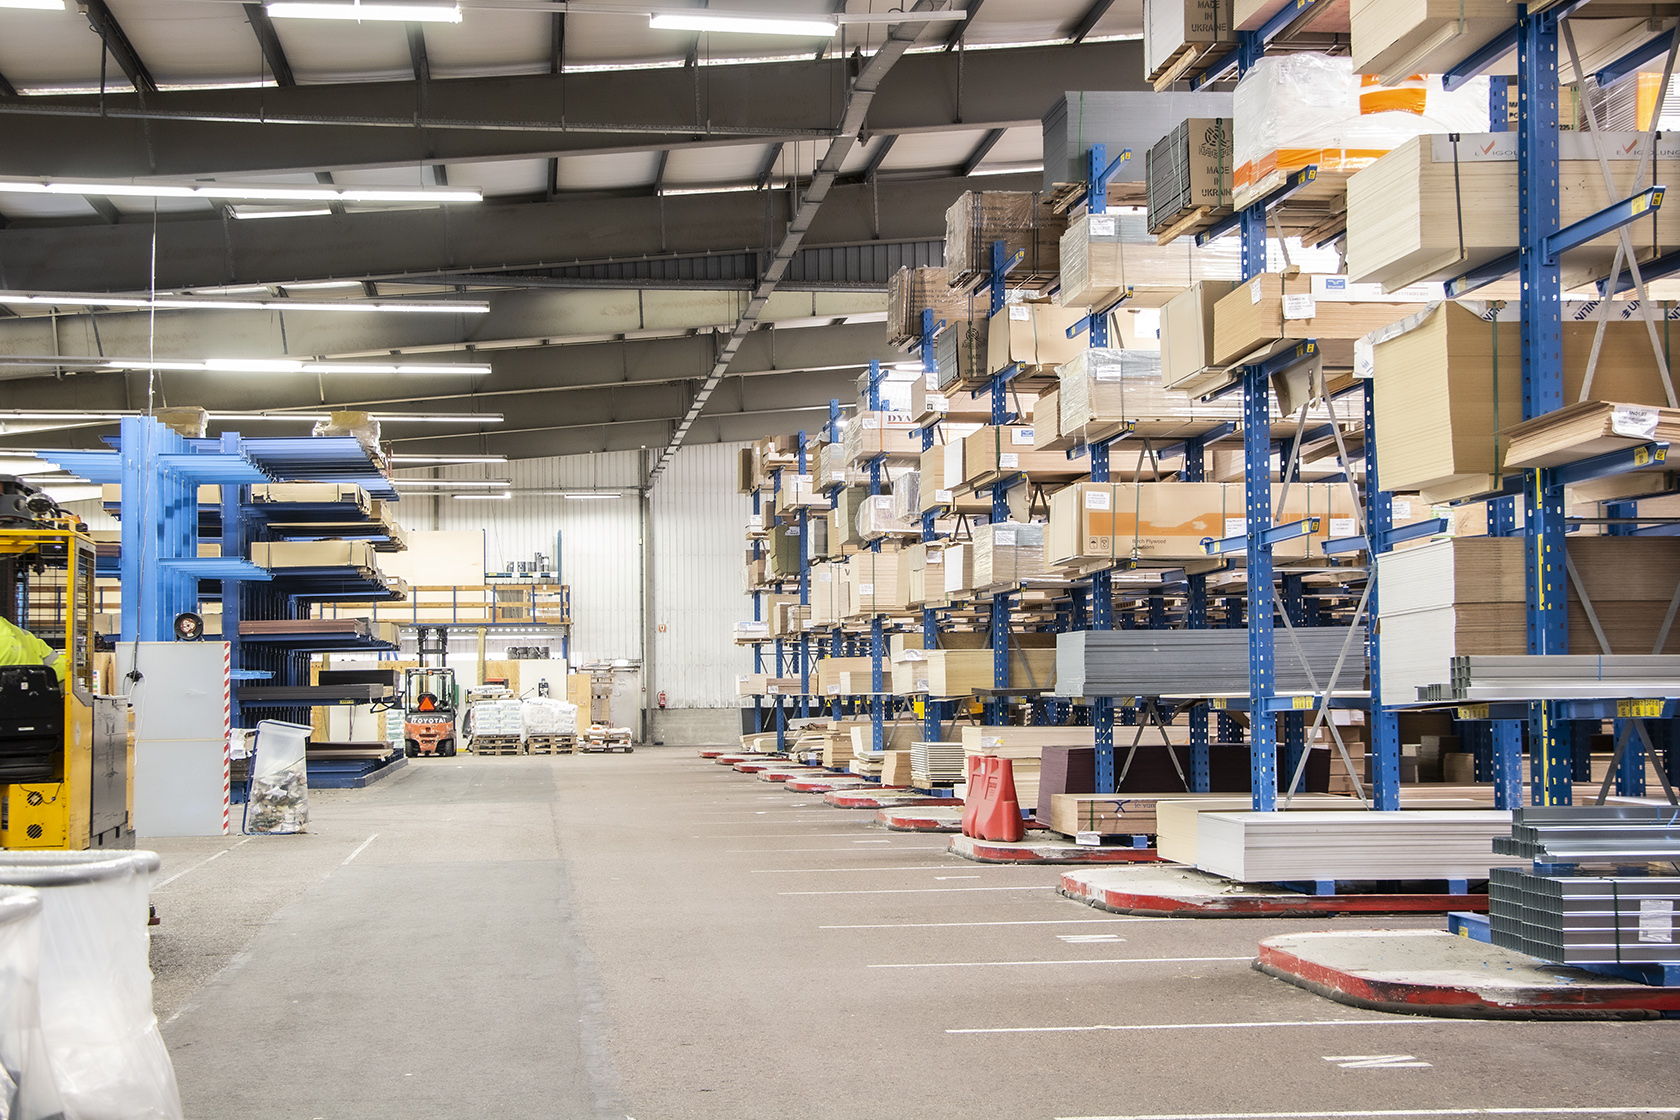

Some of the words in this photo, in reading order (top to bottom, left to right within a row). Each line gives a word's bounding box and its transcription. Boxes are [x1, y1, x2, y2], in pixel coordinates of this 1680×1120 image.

[1204, 12, 1213, 20] IN
[1191, 23, 1227, 33] UKRANE
[1574, 299, 1600, 321] NILIN
